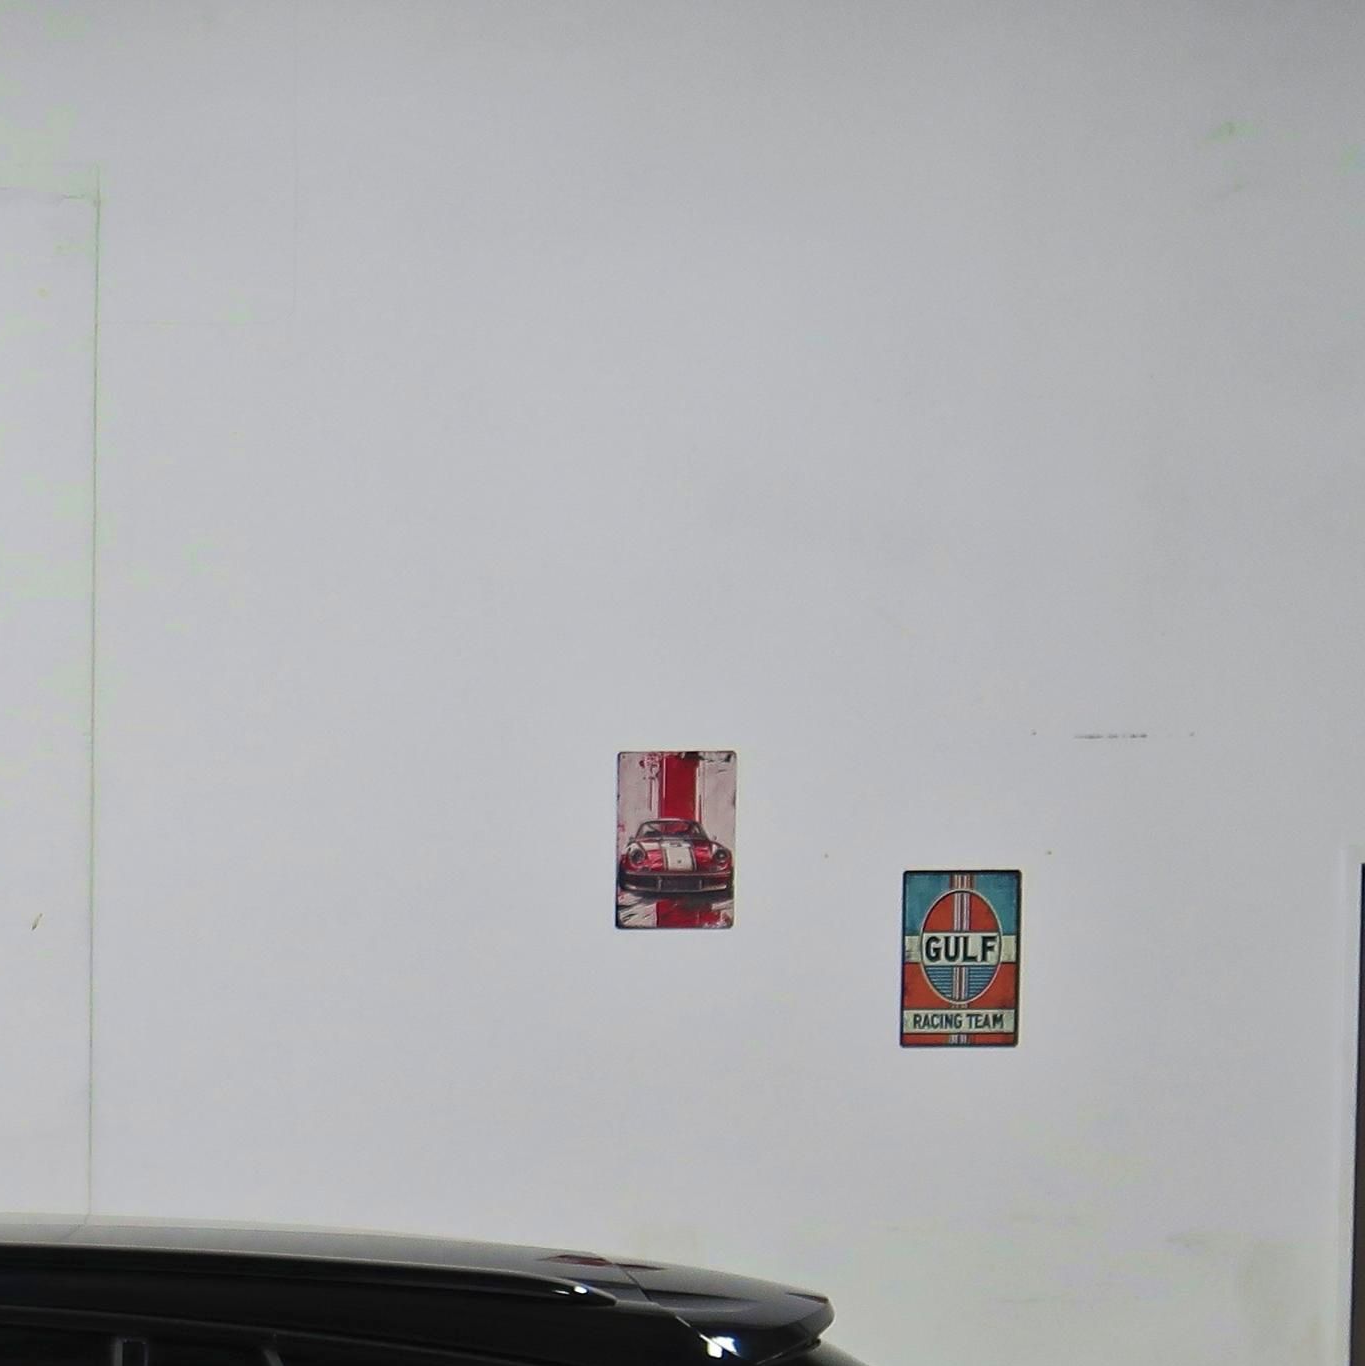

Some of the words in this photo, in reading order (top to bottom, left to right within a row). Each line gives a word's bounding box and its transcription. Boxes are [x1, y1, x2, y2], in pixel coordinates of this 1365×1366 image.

[925, 935, 997, 962] GULF
[913, 1013, 962, 1030] RACING
[966, 1013, 1004, 1030] TEAM
